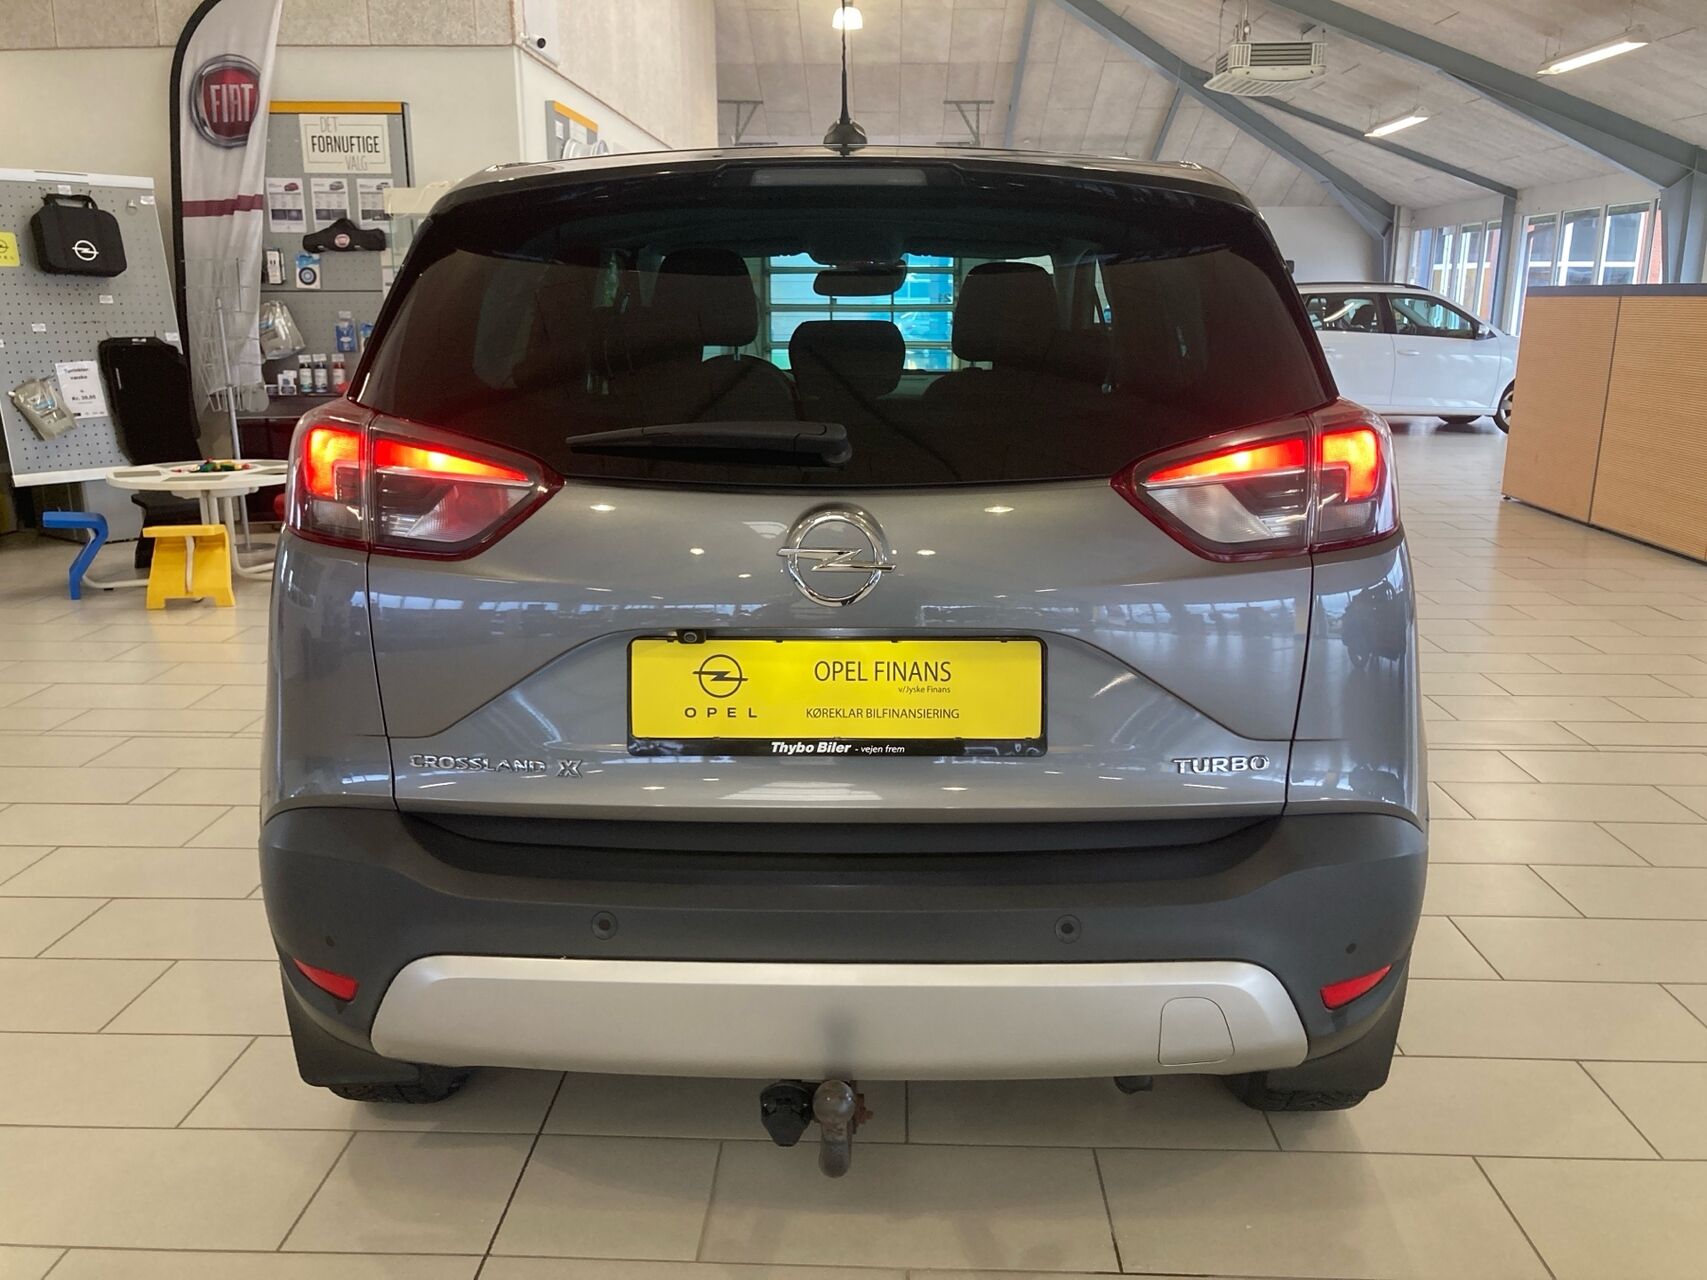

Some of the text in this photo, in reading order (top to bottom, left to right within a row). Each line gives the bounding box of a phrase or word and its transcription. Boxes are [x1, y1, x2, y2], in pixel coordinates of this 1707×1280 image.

[209, 83, 254, 123] FIAT
[320, 116, 338, 133] DET
[311, 135, 381, 154] FORNUFTIGE
[345, 155, 368, 171] VALG
[814, 661, 952, 682] OPEL FINANS
[898, 685, 951, 694] v/Jyske Finans
[684, 707, 758, 718] OPEL
[806, 708, 960, 719] KØREKLAR BILFINANSIERING
[771, 741, 814, 755] Thybo
[816, 741, 852, 754] Biler
[861, 745, 884, 755] vejen
[885, 744, 906, 753] frem
[409, 754, 582, 777] CROSSLAND X
[1172, 755, 1270, 774] TURBO
